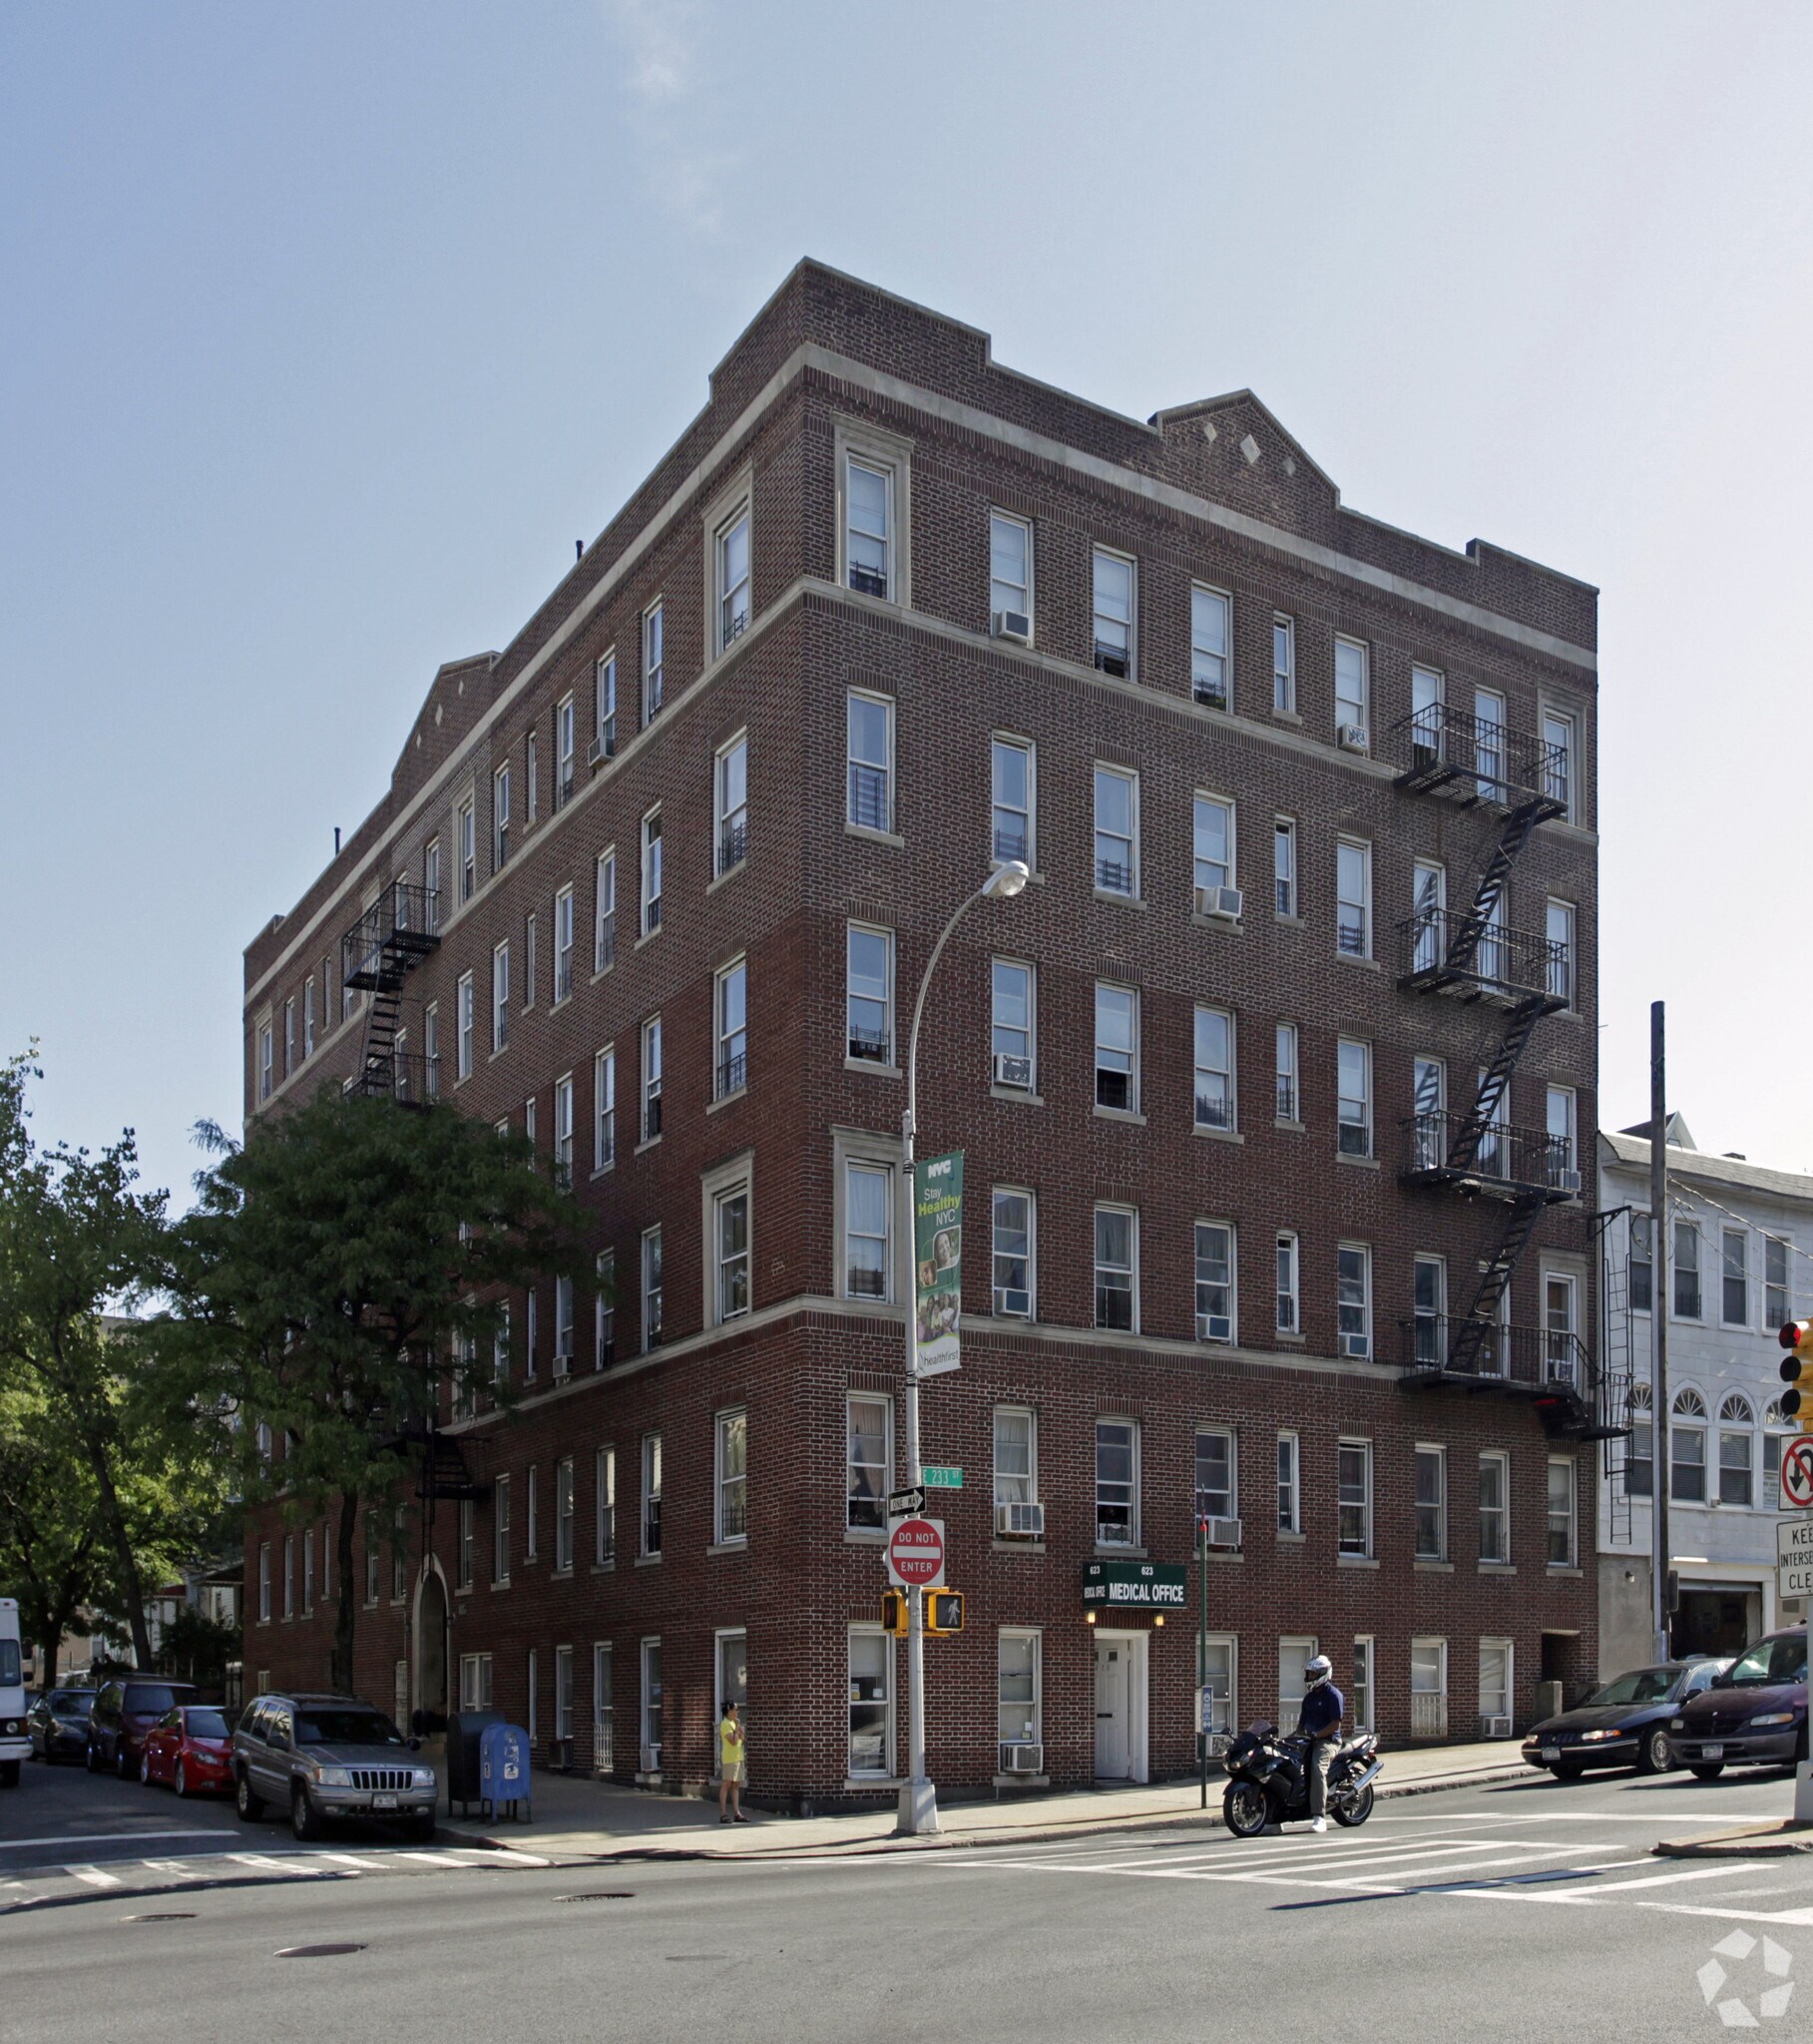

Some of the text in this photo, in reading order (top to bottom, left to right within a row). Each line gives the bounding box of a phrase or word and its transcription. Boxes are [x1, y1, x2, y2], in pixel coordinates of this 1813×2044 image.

[928, 1160, 951, 1179] NYC
[925, 1188, 941, 1201] Stay
[919, 1195, 961, 1217] Healthy
[936, 1209, 955, 1226] NYC
[924, 1350, 958, 1366] healthfirst
[923, 1469, 928, 1483] E
[932, 1470, 948, 1484] 233
[893, 1495, 919, 1509] ONE WAY
[899, 1533, 934, 1543] DO NOT
[1792, 1528, 1813, 1545] KEE
[901, 1562, 932, 1572] ENTER
[1781, 1551, 1813, 1567] INTERSE
[1141, 1566, 1153, 1575] 623
[1789, 1572, 1812, 1590] CLE
[1110, 1583, 1183, 1602] MEDICAL OFFICE
